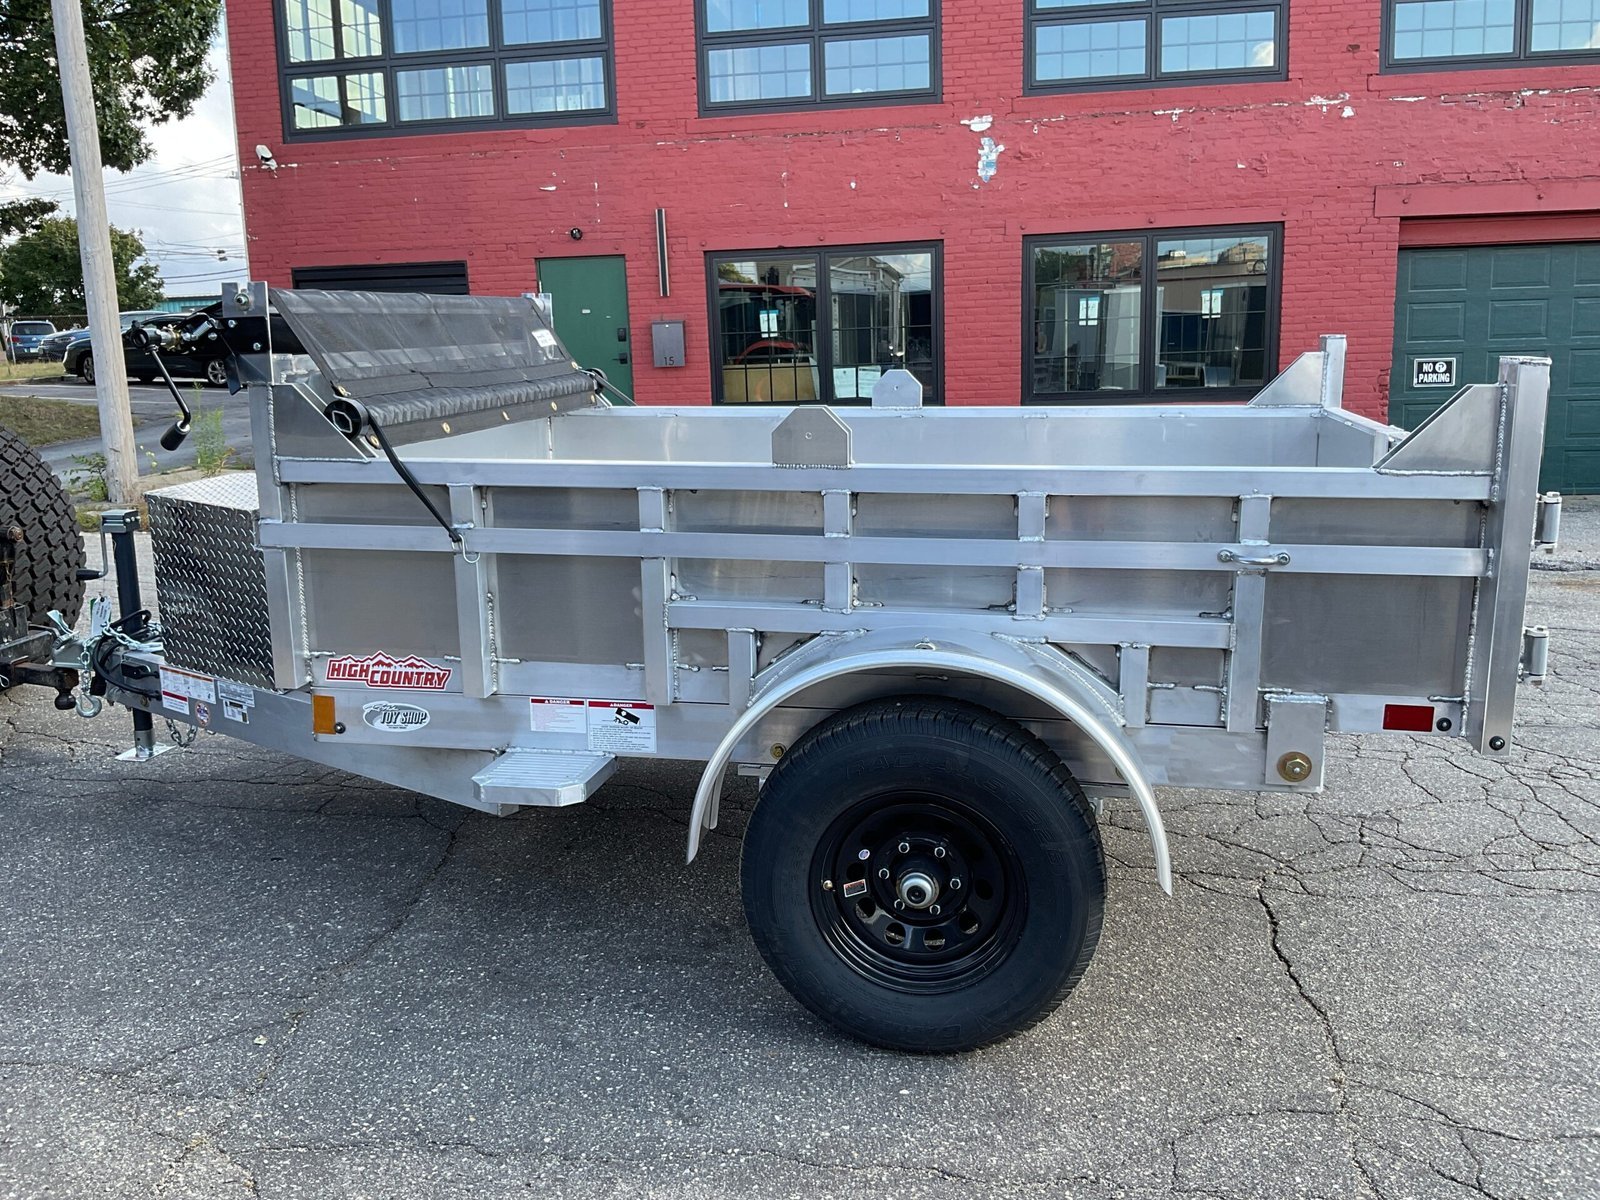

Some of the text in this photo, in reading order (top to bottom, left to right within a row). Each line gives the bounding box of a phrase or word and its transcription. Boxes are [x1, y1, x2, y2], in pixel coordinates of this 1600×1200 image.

[664, 356, 675, 366] 15
[1422, 362, 1433, 372] NO
[1418, 373, 1450, 383] PARKING
[330, 662, 370, 678] HIGH
[369, 670, 448, 687] COUNTRY
[381, 711, 428, 725] TOY SHOP
